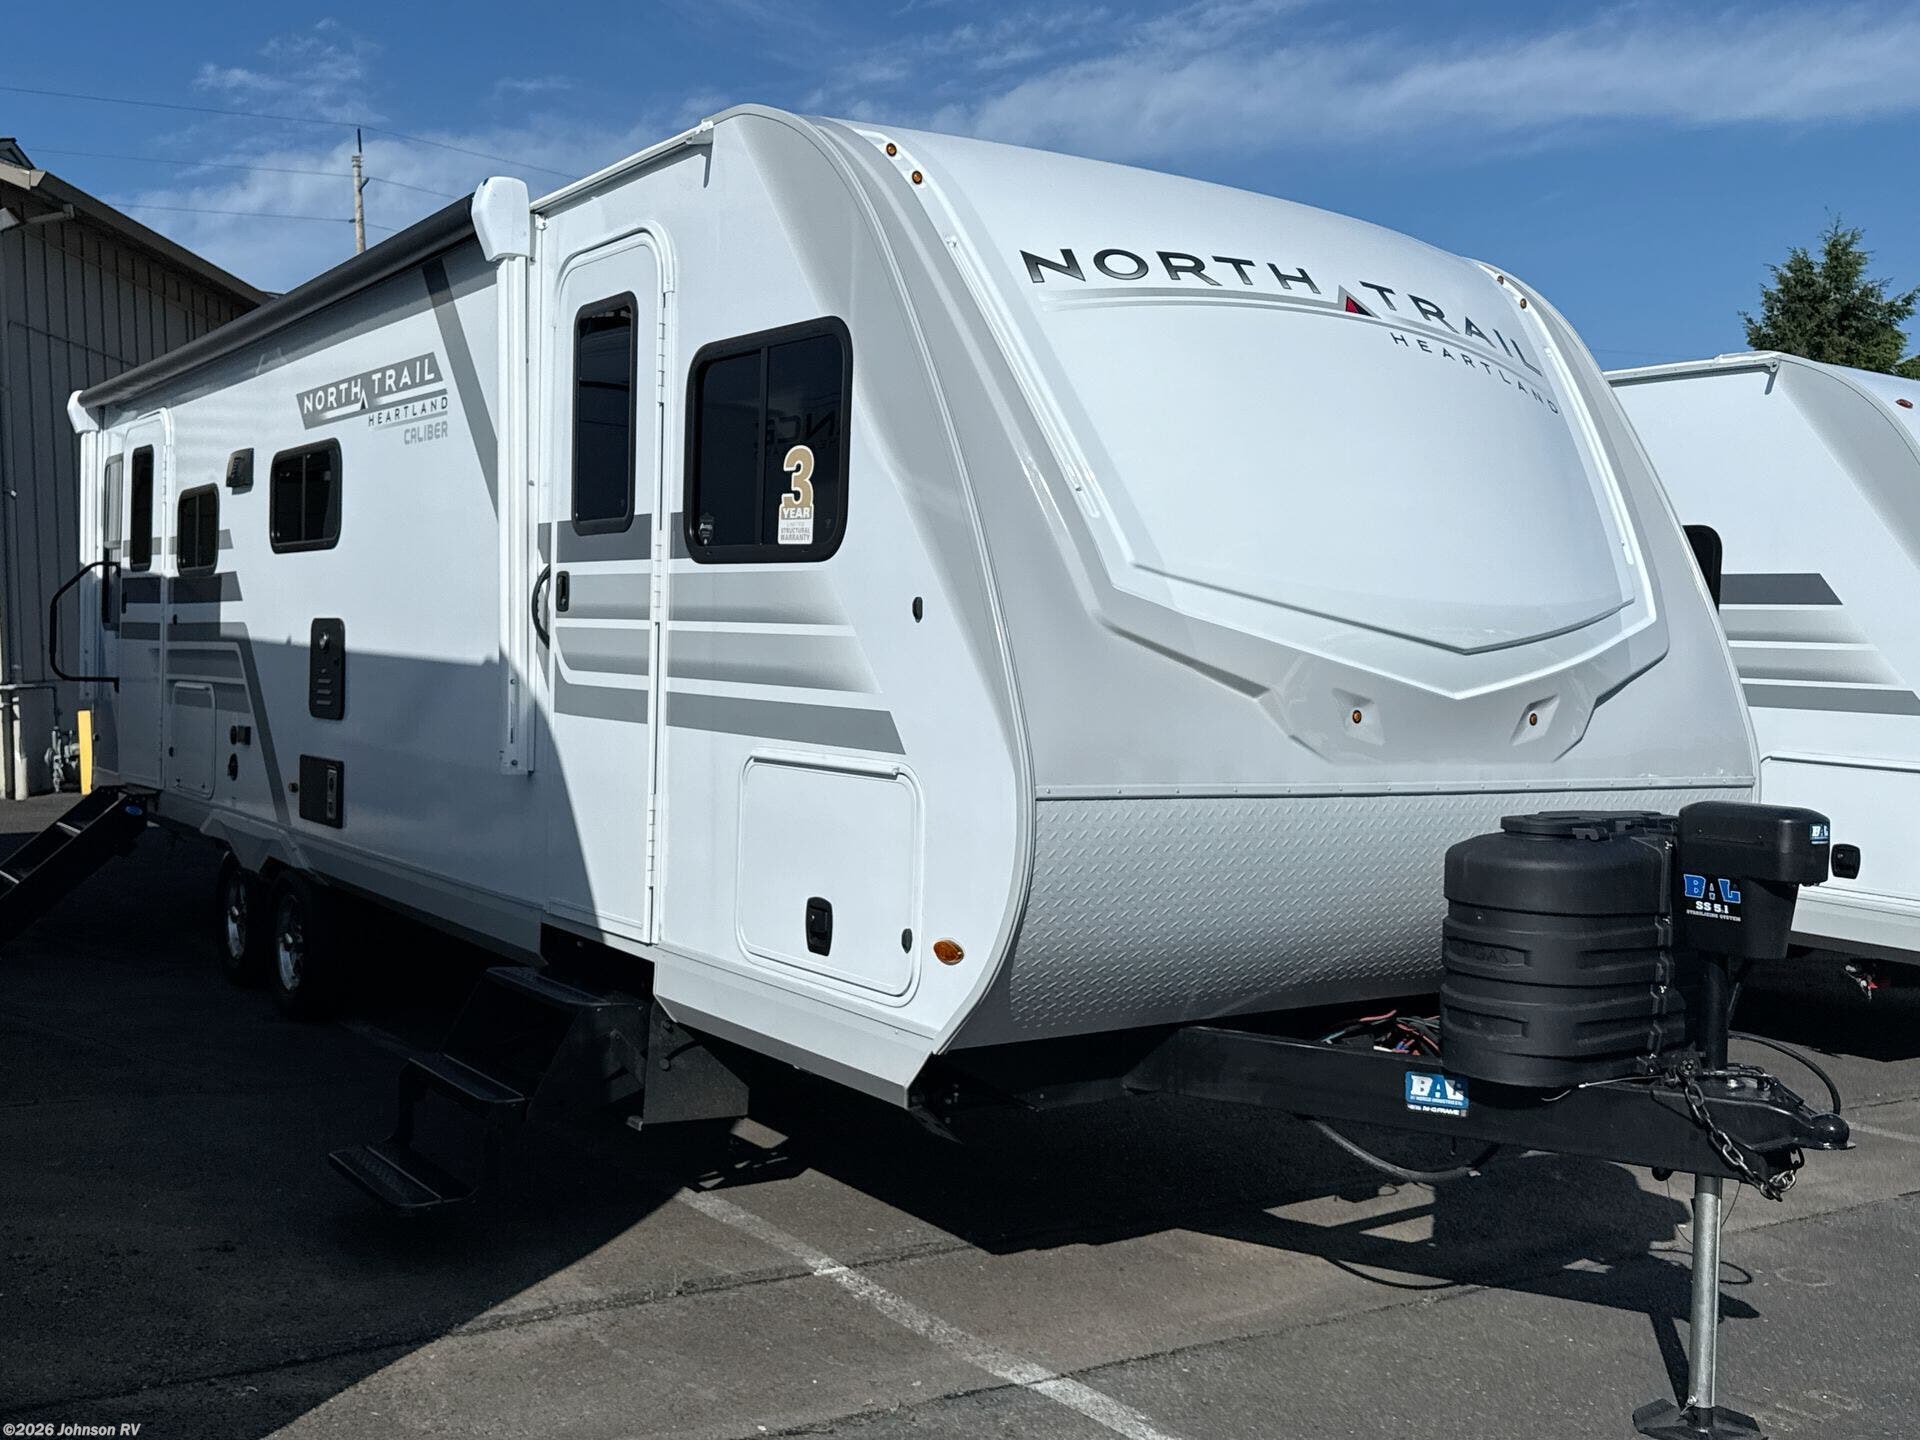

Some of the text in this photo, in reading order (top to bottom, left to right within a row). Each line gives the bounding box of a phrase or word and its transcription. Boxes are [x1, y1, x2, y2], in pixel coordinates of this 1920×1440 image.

[1020, 248, 1543, 376] NORTH TRAIL
[304, 358, 435, 414] NORTH TRAIL
[1390, 332, 1559, 414] HEARTLAND
[368, 396, 448, 427] HEARTLAND
[404, 420, 448, 445] CALIBER
[782, 445, 814, 507] 3
[782, 507, 811, 519] YEAR
[1683, 873, 1741, 904] BAL
[1695, 901, 1712, 911] SS
[1410, 1074, 1465, 1101] BAL
